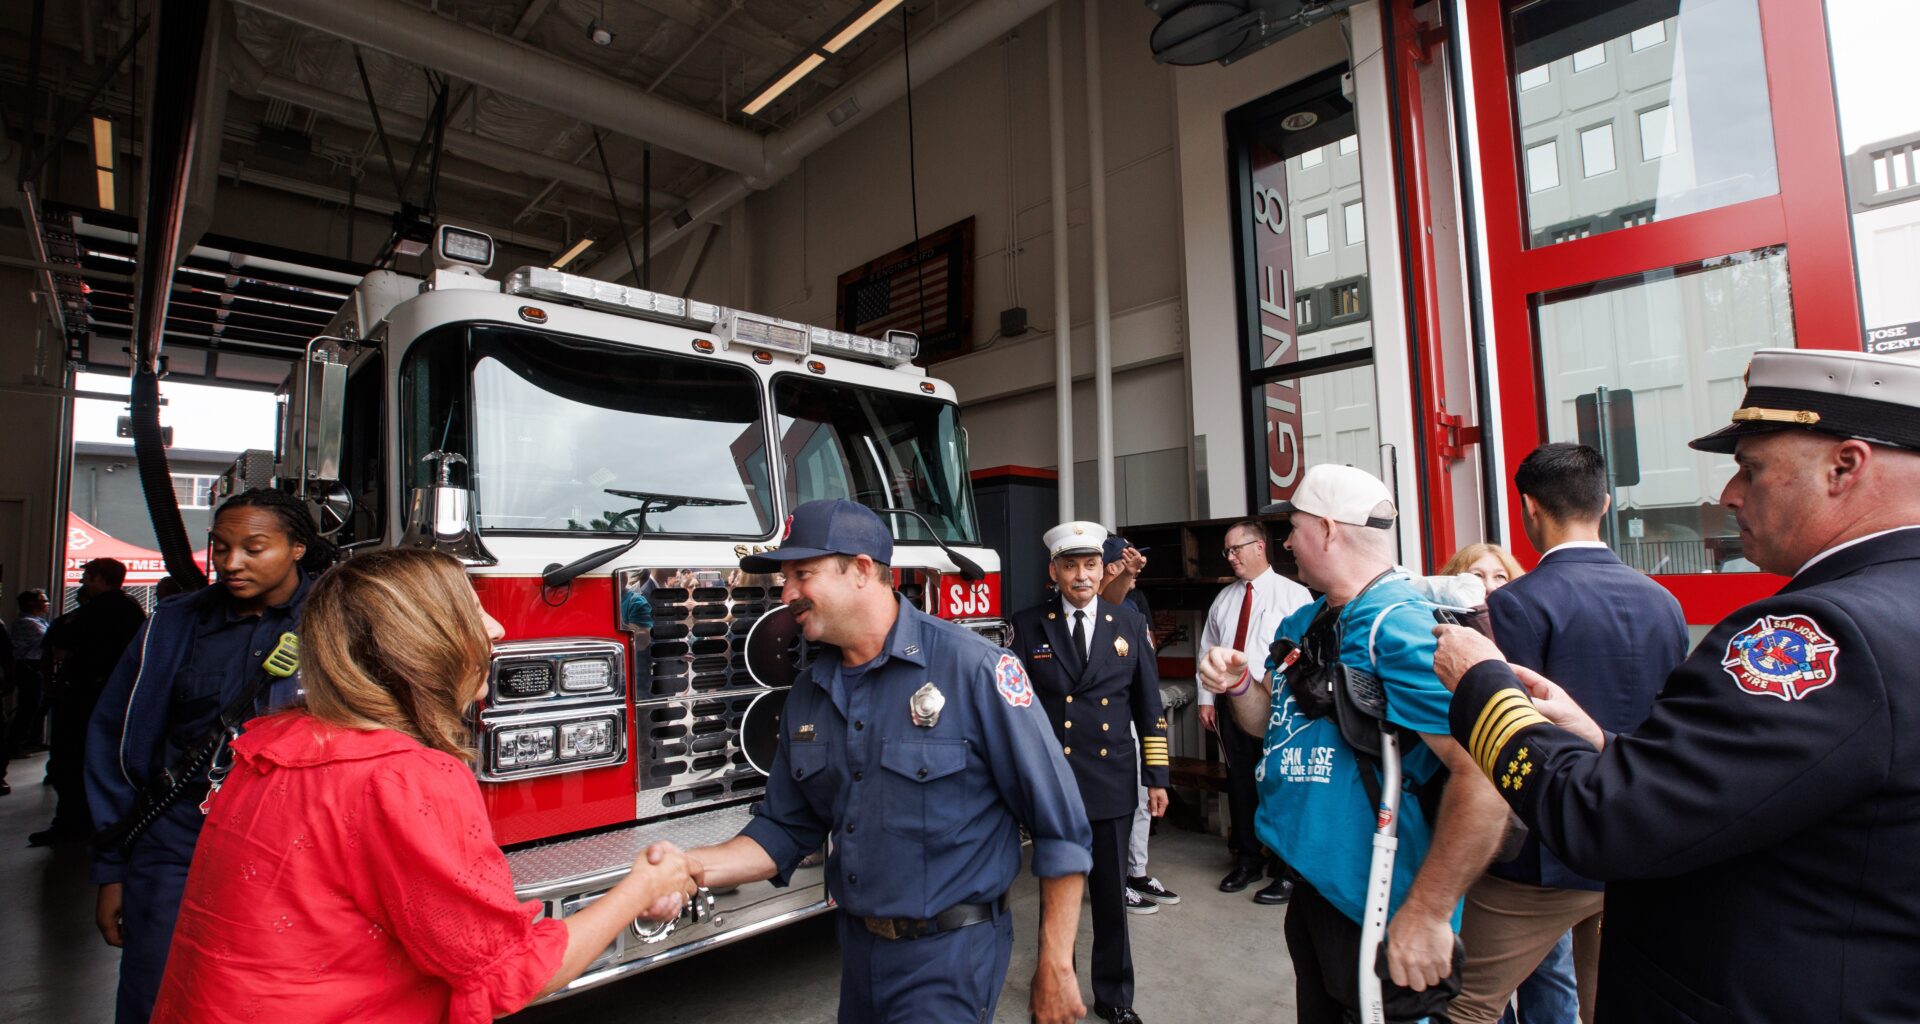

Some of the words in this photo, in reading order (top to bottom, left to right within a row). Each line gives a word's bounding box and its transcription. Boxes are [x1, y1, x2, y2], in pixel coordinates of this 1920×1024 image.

[1253, 182, 1287, 235] 8
[1867, 326, 1908, 343] JOSE
[1260, 265, 1299, 505] GINE
[950, 583, 990, 616] SJS
[1773, 620, 1796, 630] SAN
[1794, 625, 1821, 643] JOSE
[1740, 671, 1769, 689] FIRE
[1281, 747, 1302, 766] SAN
[1308, 746, 1336, 766] JSE
